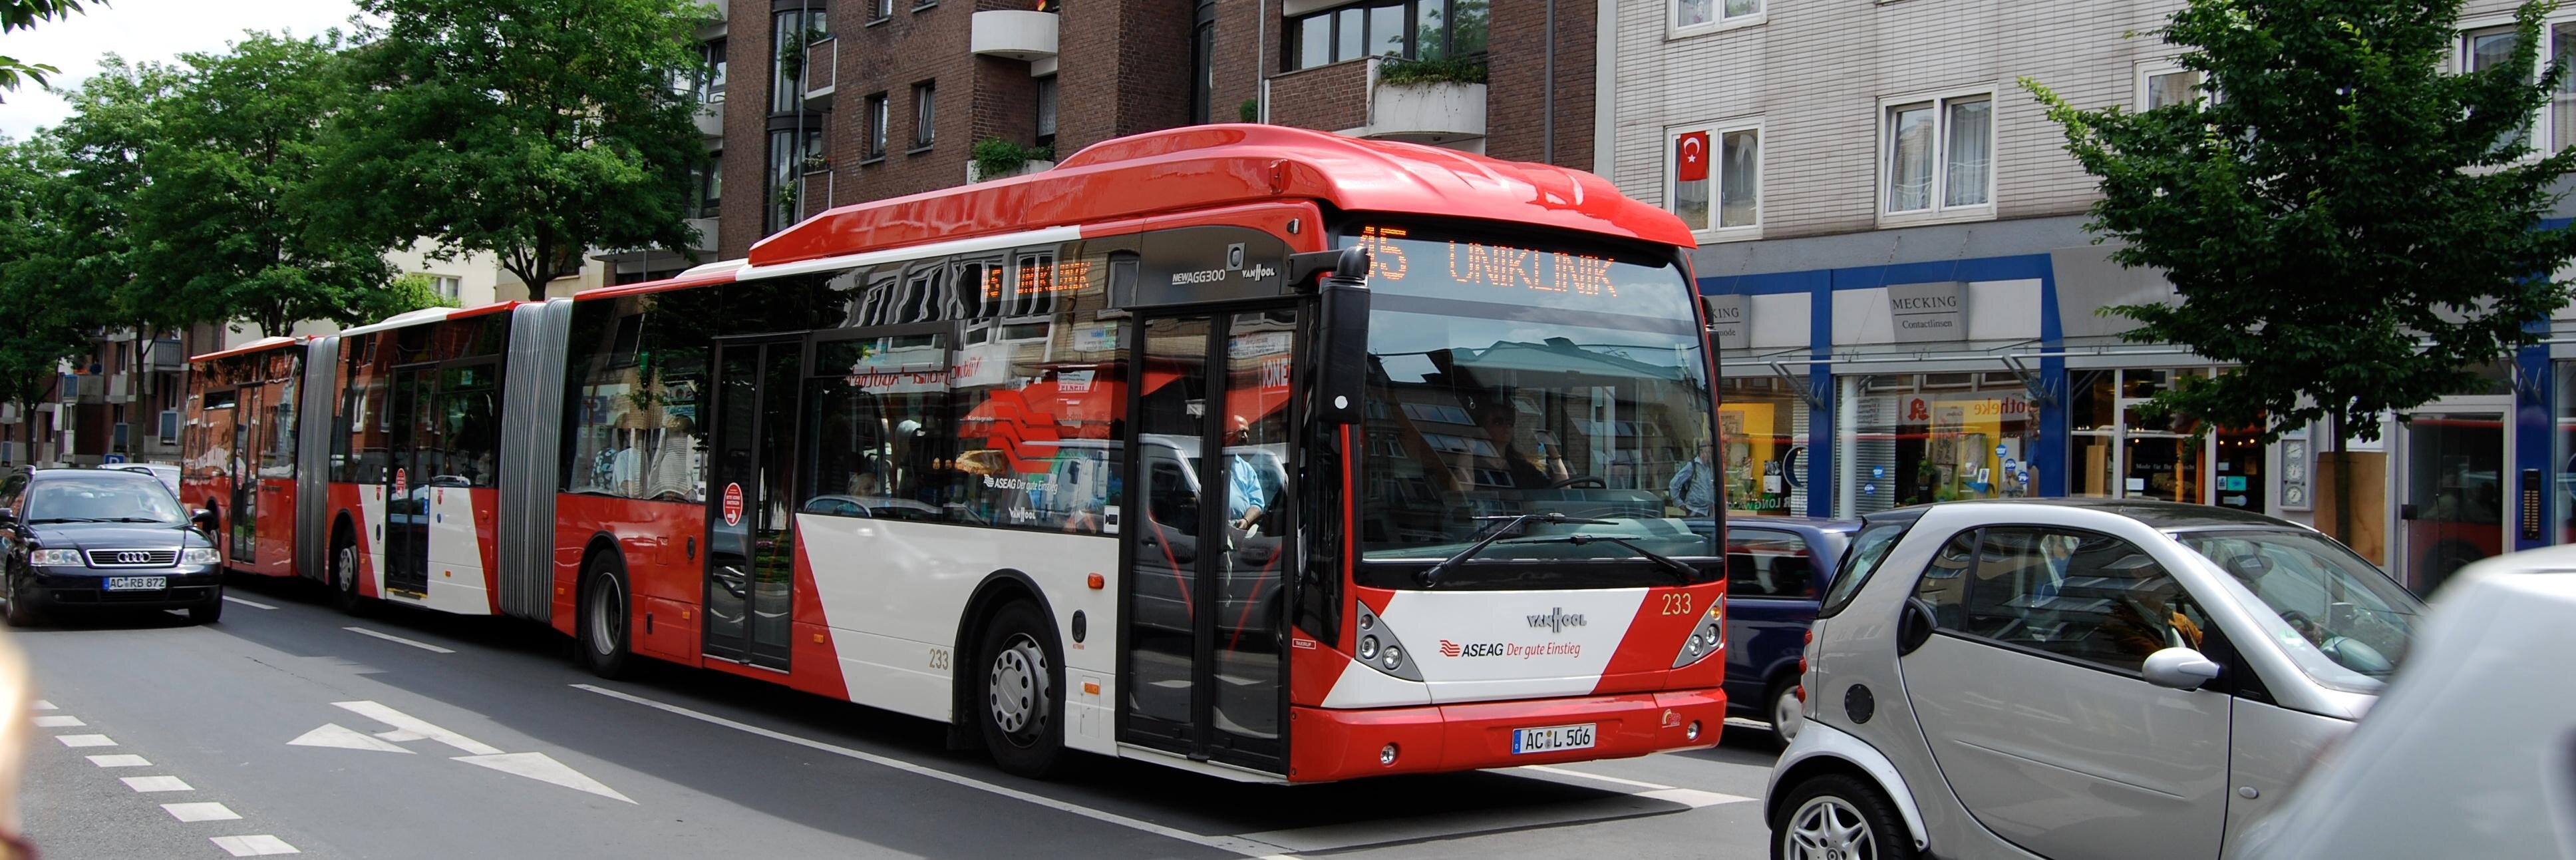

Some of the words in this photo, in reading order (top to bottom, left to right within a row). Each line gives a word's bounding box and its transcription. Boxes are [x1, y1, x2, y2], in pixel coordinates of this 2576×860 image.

[1356, 226, 1407, 280] 45
[1449, 240, 1618, 298] UNIKLINIK
[1892, 296, 1957, 310] MECKING
[1902, 320, 1953, 329] Contactlinsen
[994, 477, 1017, 490] ASEAG
[1017, 479, 1026, 490] Der
[1026, 482, 1038, 493] gute
[1038, 480, 1058, 495] Einstieg
[110, 578, 123, 587] AC
[130, 578, 144, 587] RB
[146, 577, 165, 587] 872
[1662, 593, 1691, 615] 233
[929, 648, 949, 670] 233
[1462, 642, 1504, 658] ASEAG
[1506, 643, 1522, 656] Der
[1524, 643, 1544, 660] gute
[1546, 641, 1581, 658] Einstieg
[1526, 731, 1543, 750] AC
[1553, 730, 1562, 748] L
[1566, 728, 1591, 747] 506
